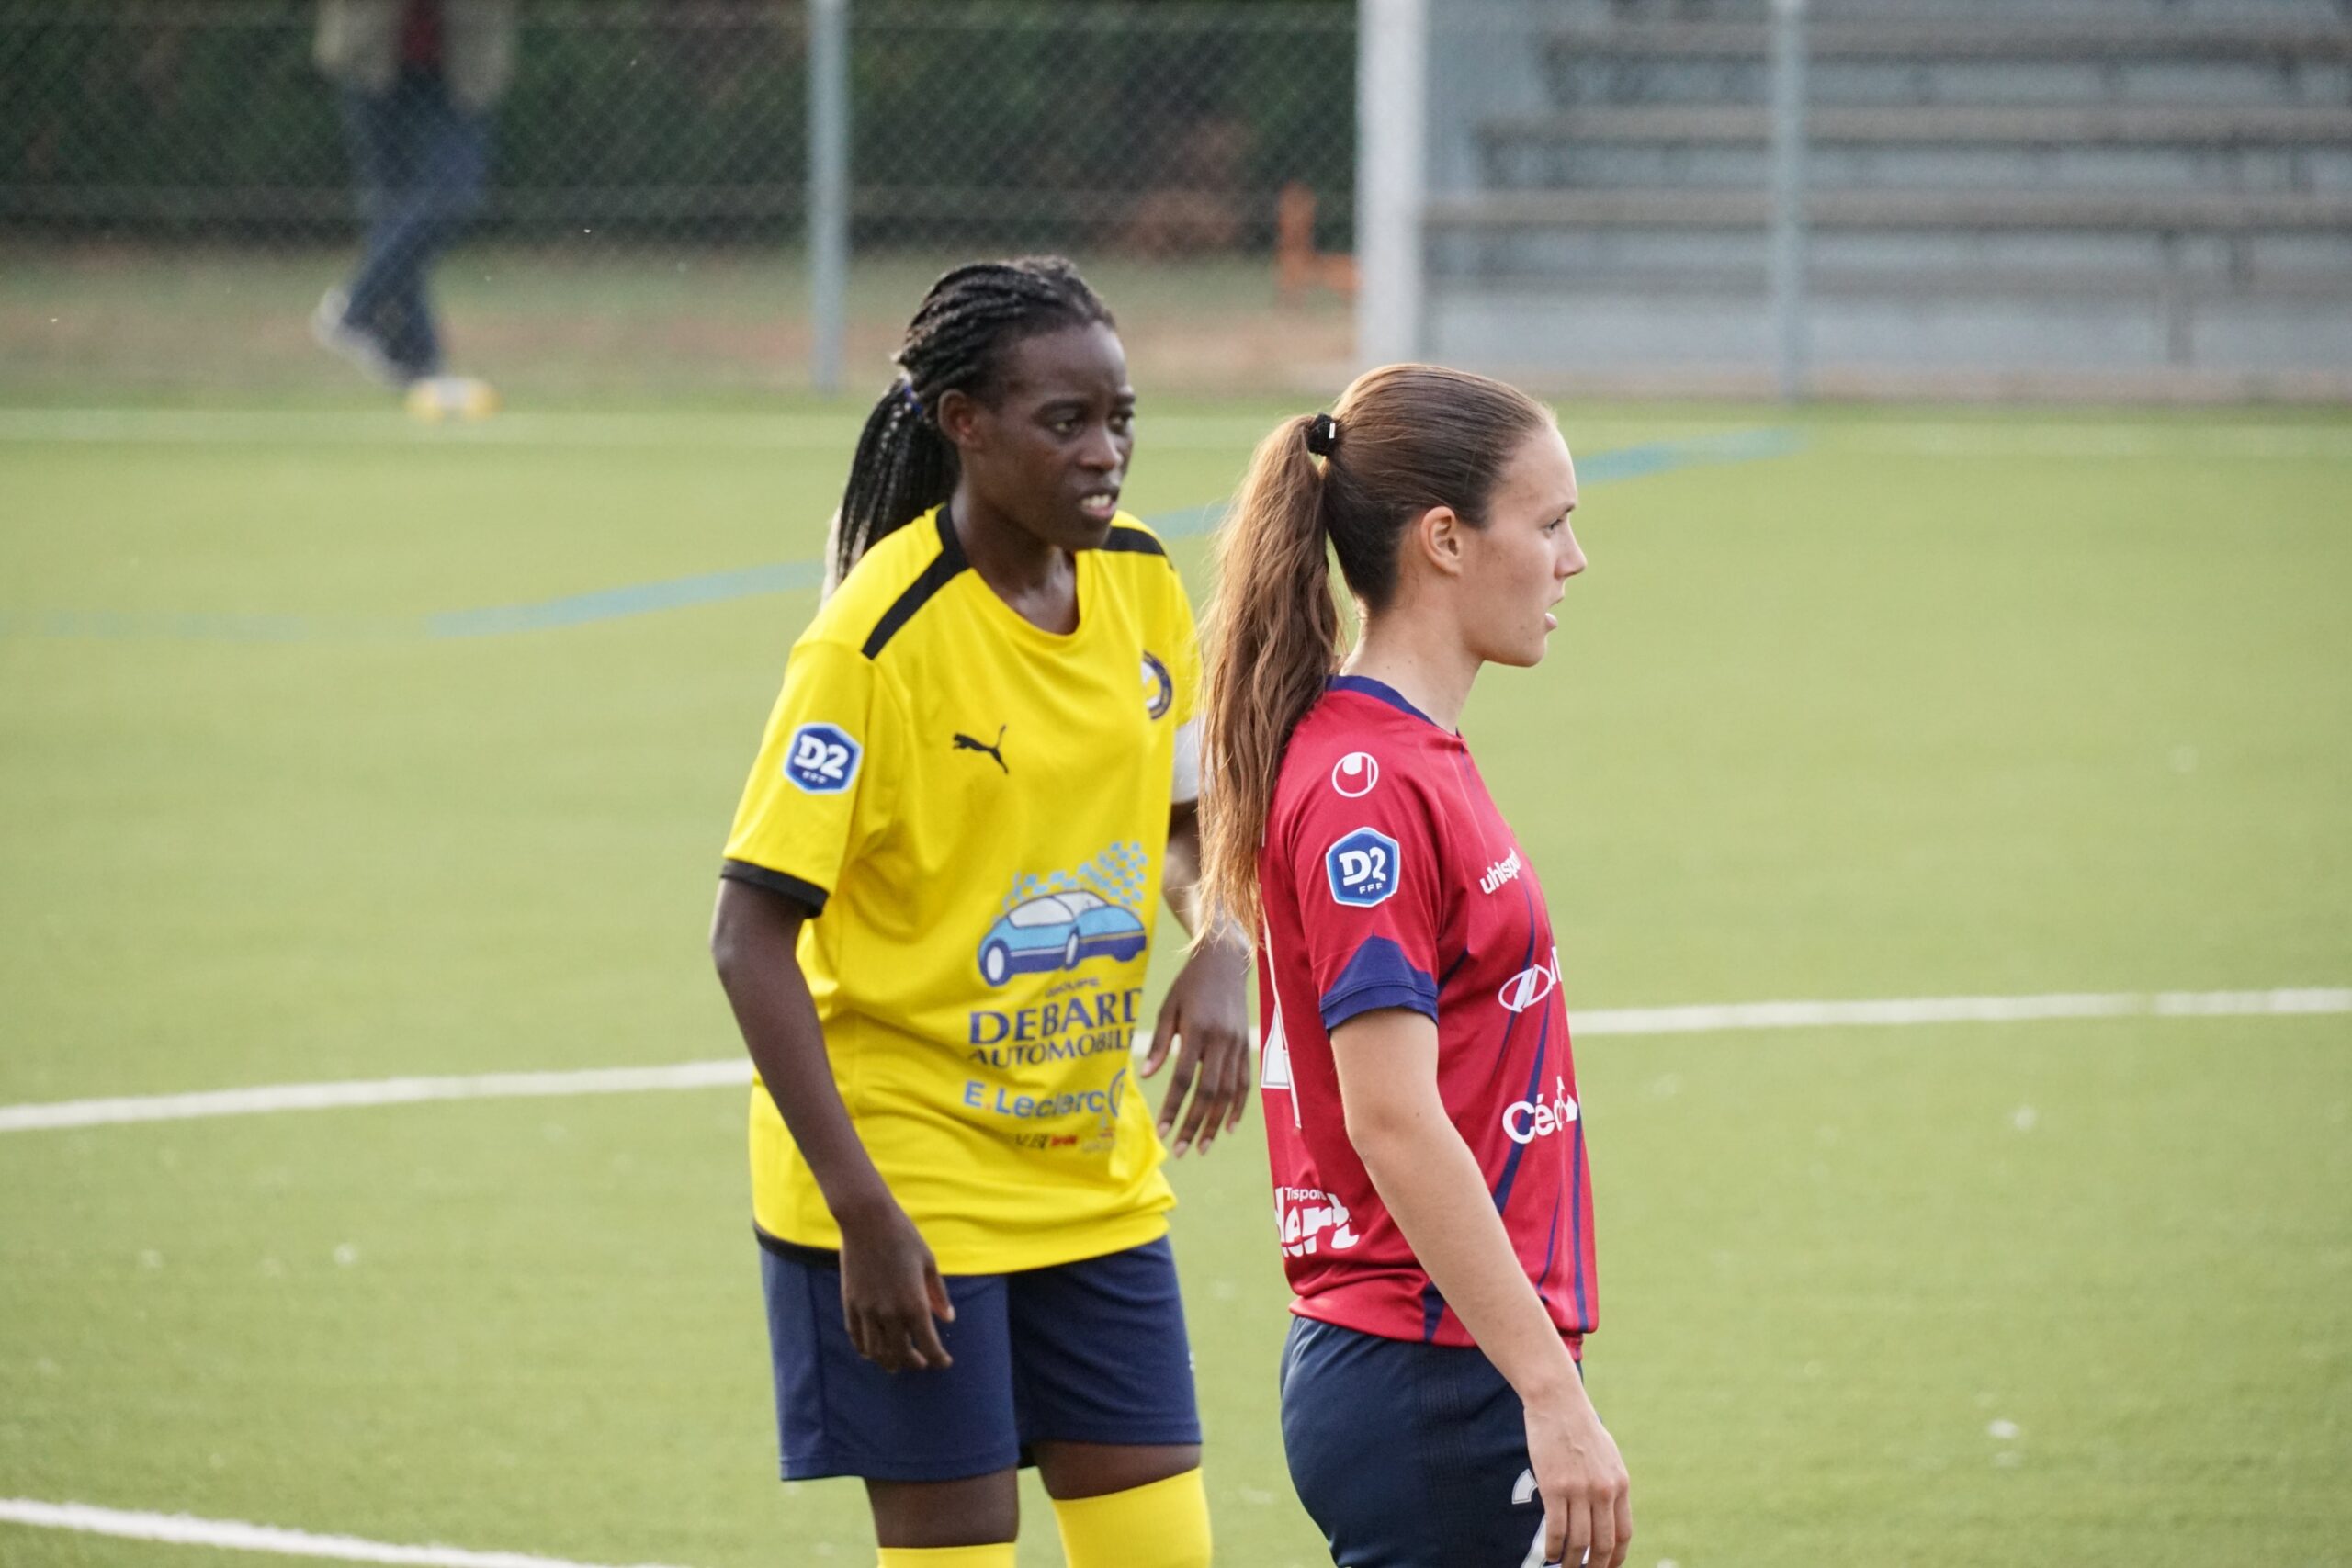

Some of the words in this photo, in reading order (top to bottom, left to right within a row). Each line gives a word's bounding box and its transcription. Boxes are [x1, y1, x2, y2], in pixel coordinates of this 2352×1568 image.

[794, 735, 849, 780] D2
[1339, 846, 1386, 886] D2
[1359, 882, 1383, 895] FFF
